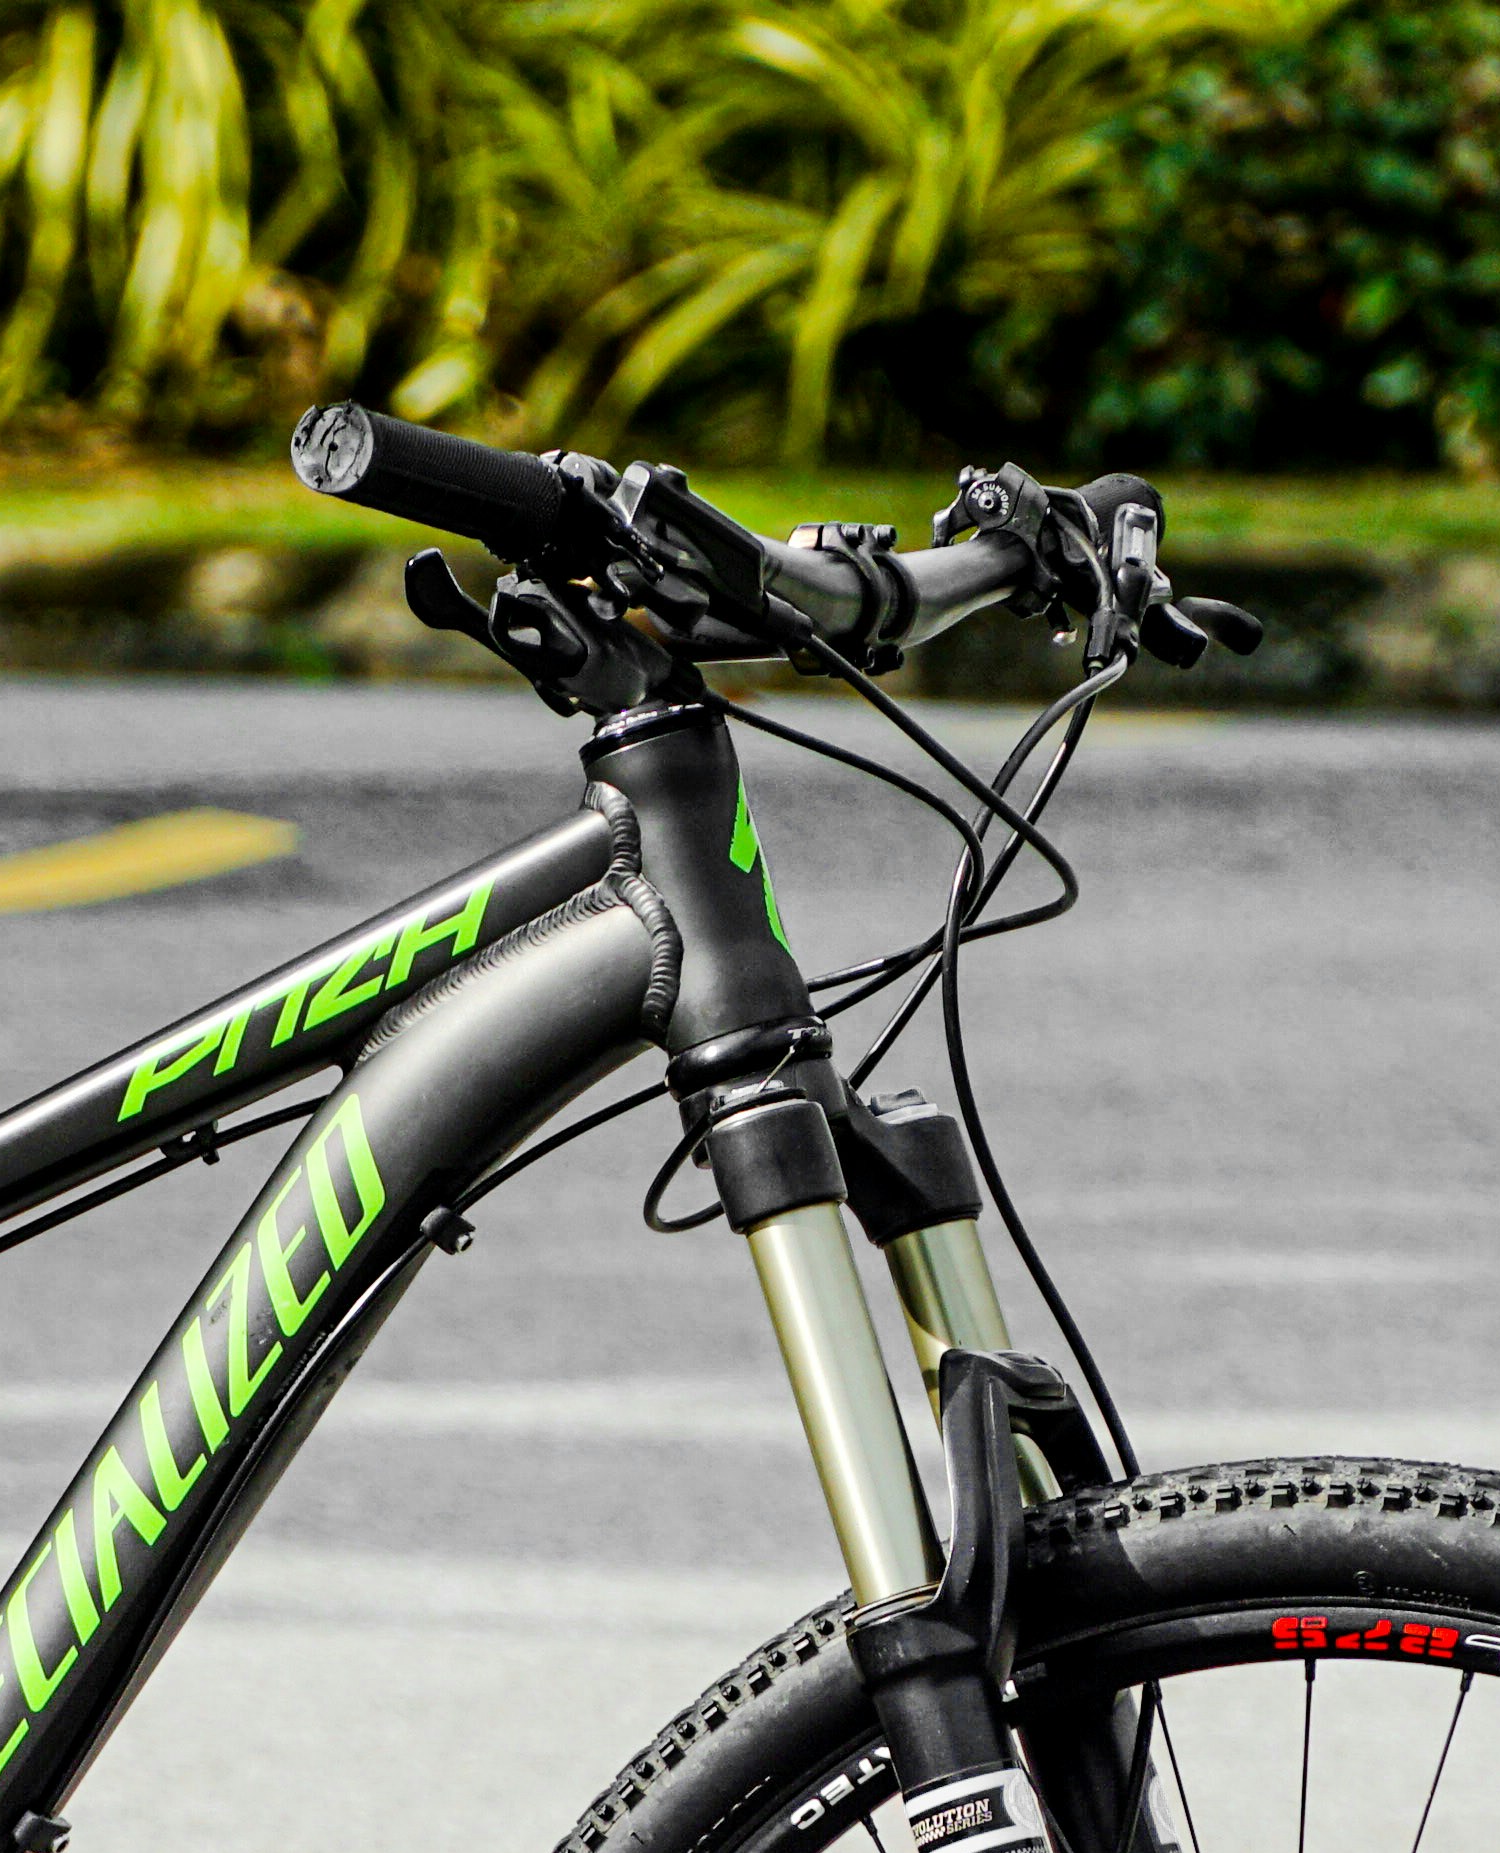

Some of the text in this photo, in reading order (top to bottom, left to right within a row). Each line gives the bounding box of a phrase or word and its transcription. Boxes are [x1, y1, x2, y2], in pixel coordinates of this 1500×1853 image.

[982, 483, 1010, 515] SUNTOUR
[117, 880, 497, 1122] PITCH
[910, 1799, 991, 1838] VOLUTION
[946, 1811, 993, 1834] SERIES
